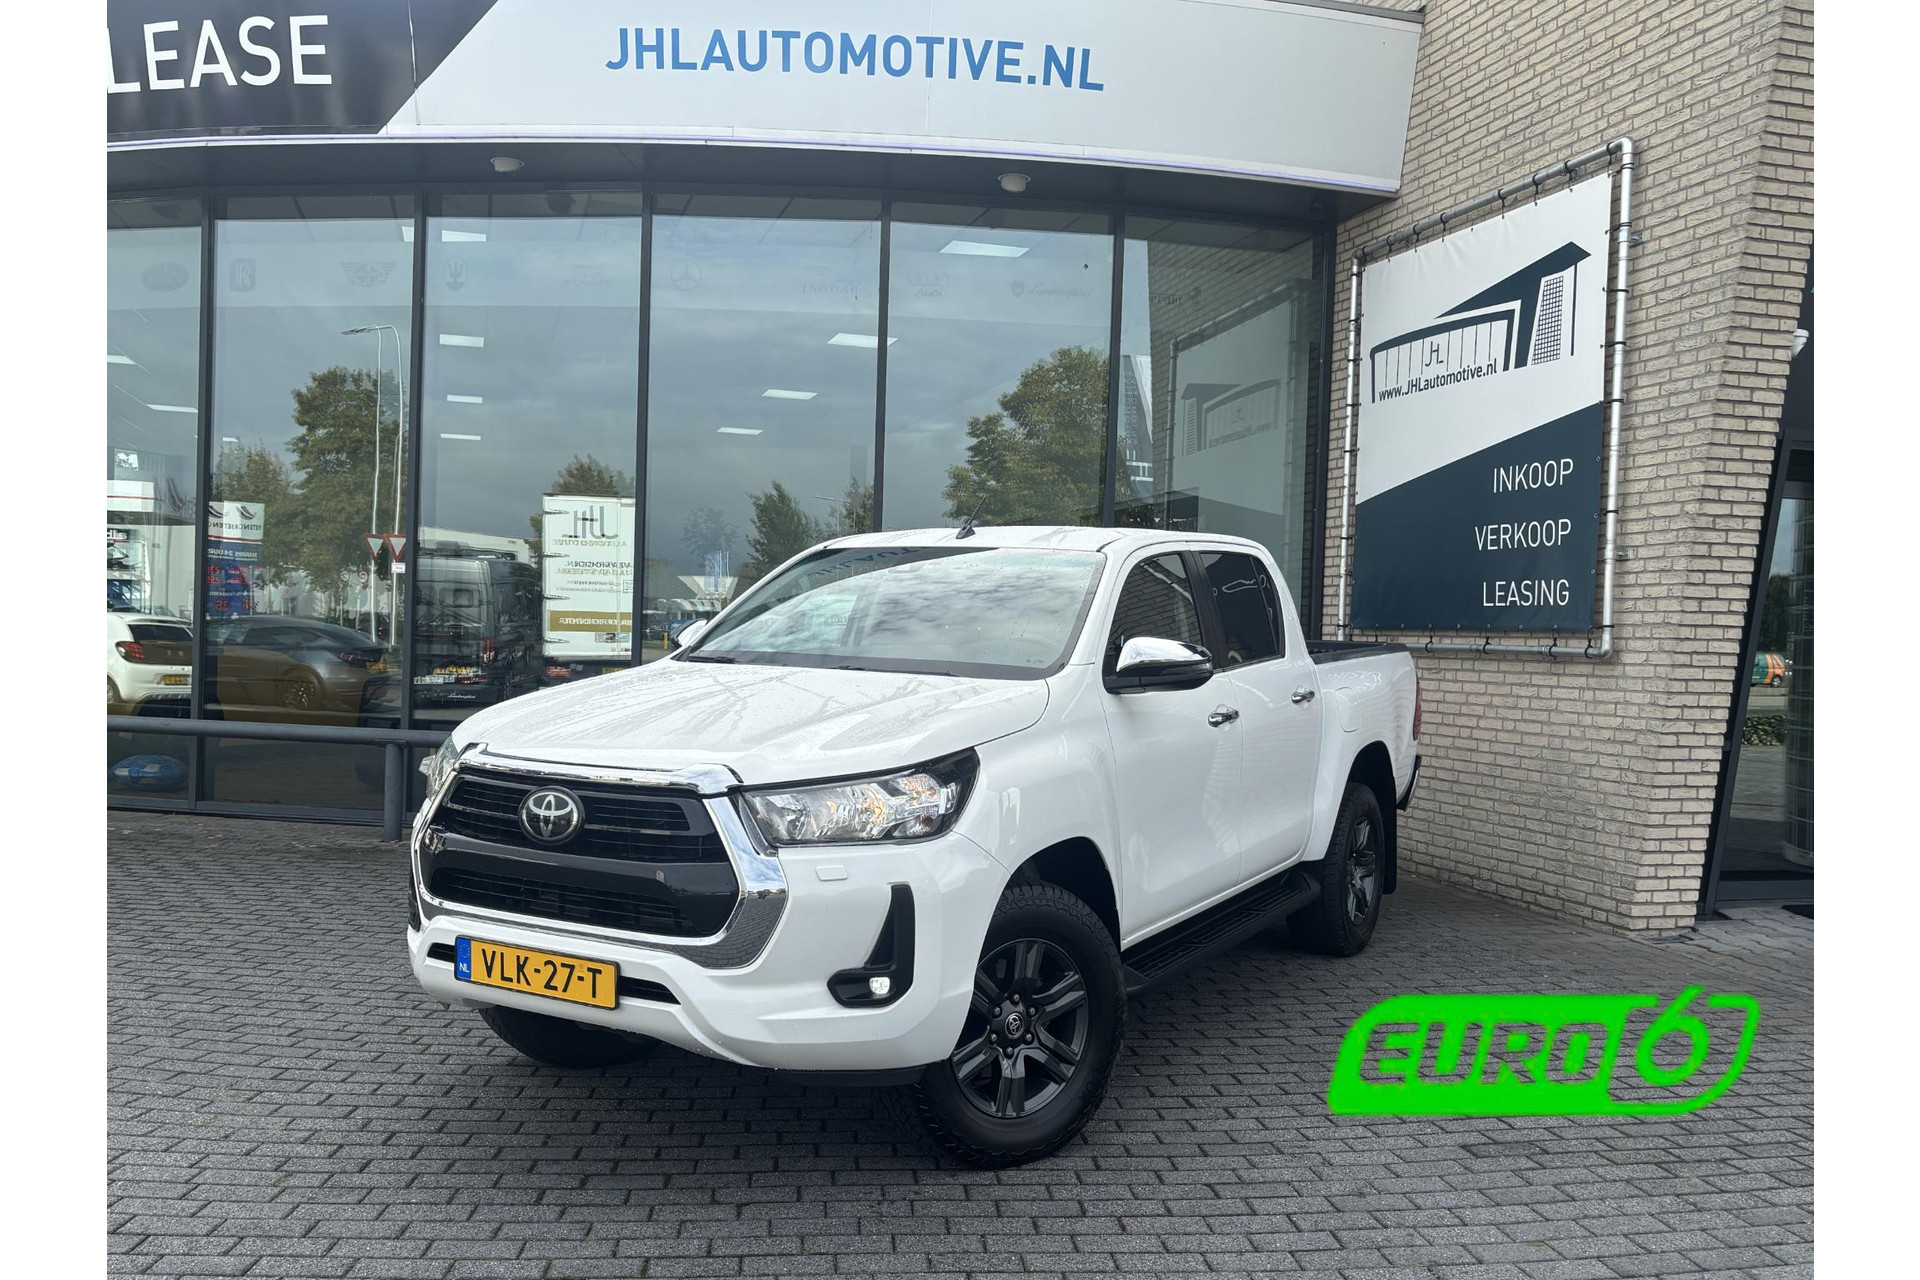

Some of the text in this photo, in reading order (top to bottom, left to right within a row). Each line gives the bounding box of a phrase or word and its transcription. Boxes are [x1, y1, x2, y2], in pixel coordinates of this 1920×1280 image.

[605, 27, 1105, 92] JHLAUTOMOTIVE.NL
[1378, 357, 1498, 402] www.JHLautomotive.nl
[1492, 458, 1574, 494] INKOOP
[1474, 518, 1572, 551] VERKOOP
[1482, 578, 1570, 607] LEASING
[459, 962, 470, 973] NL
[481, 948, 603, 999] VLK-27-T
